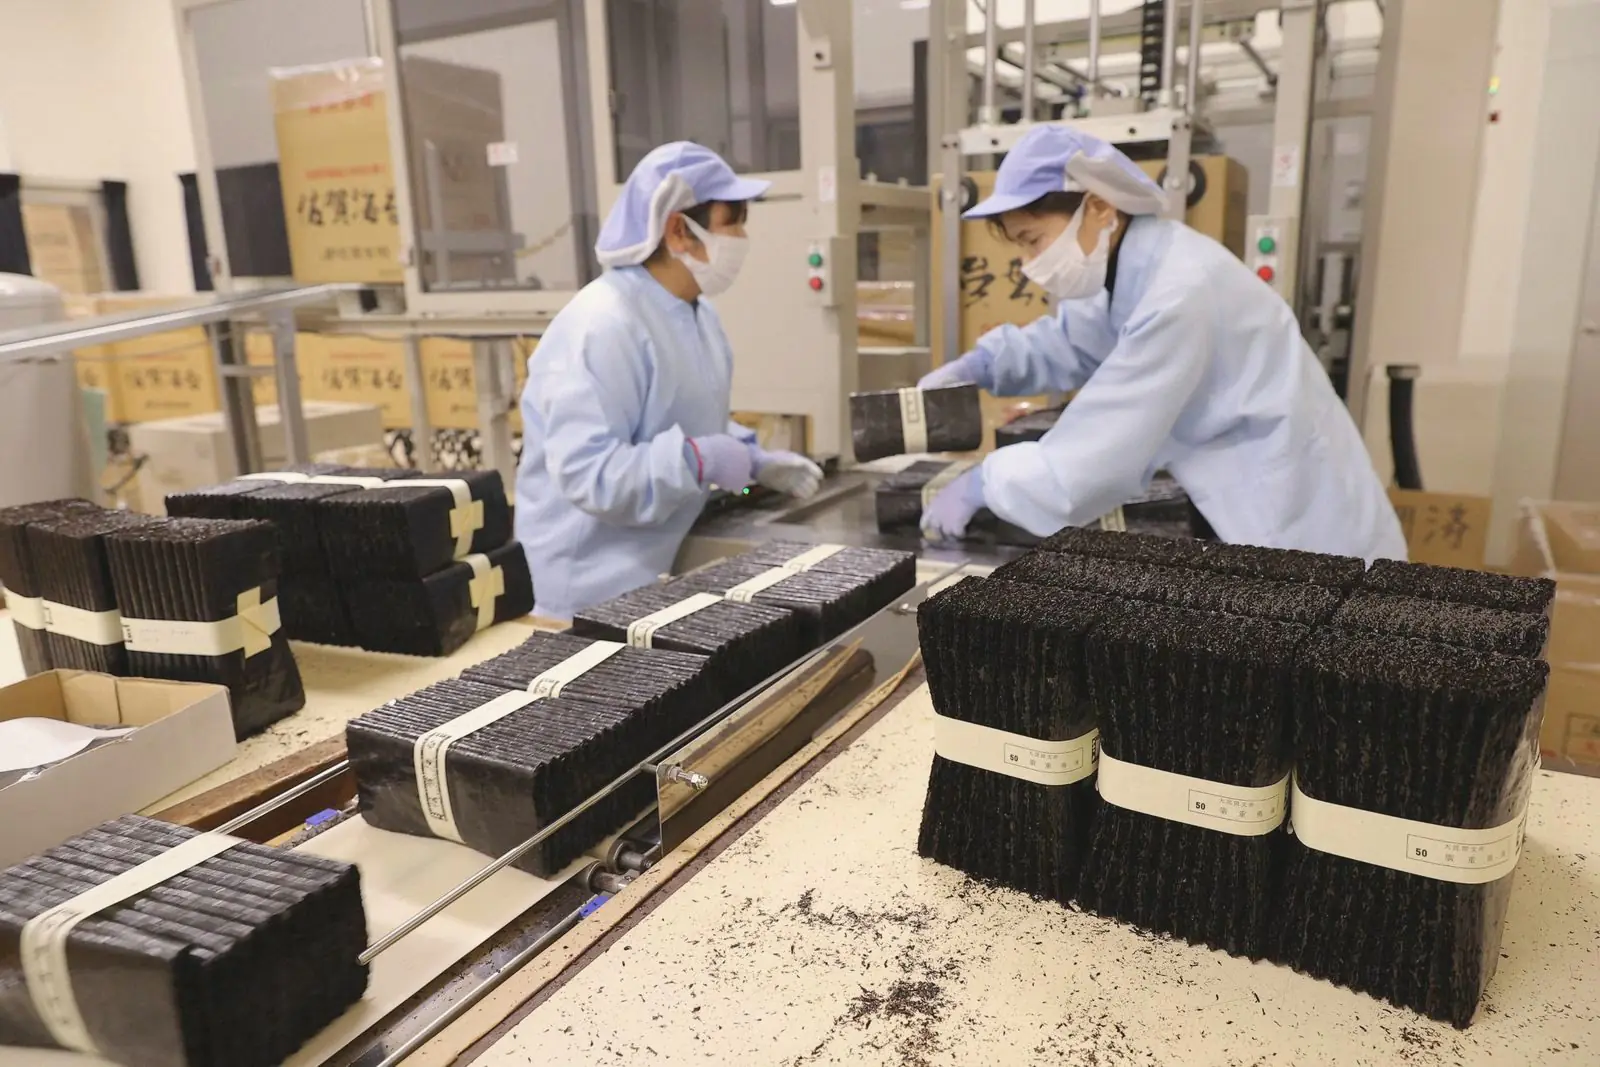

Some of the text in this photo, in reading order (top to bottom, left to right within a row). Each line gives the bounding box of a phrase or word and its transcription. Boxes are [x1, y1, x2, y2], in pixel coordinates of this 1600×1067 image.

[1009, 753, 1019, 762] 50
[1195, 801, 1206, 810] 50
[1415, 847, 1428, 858] 50
